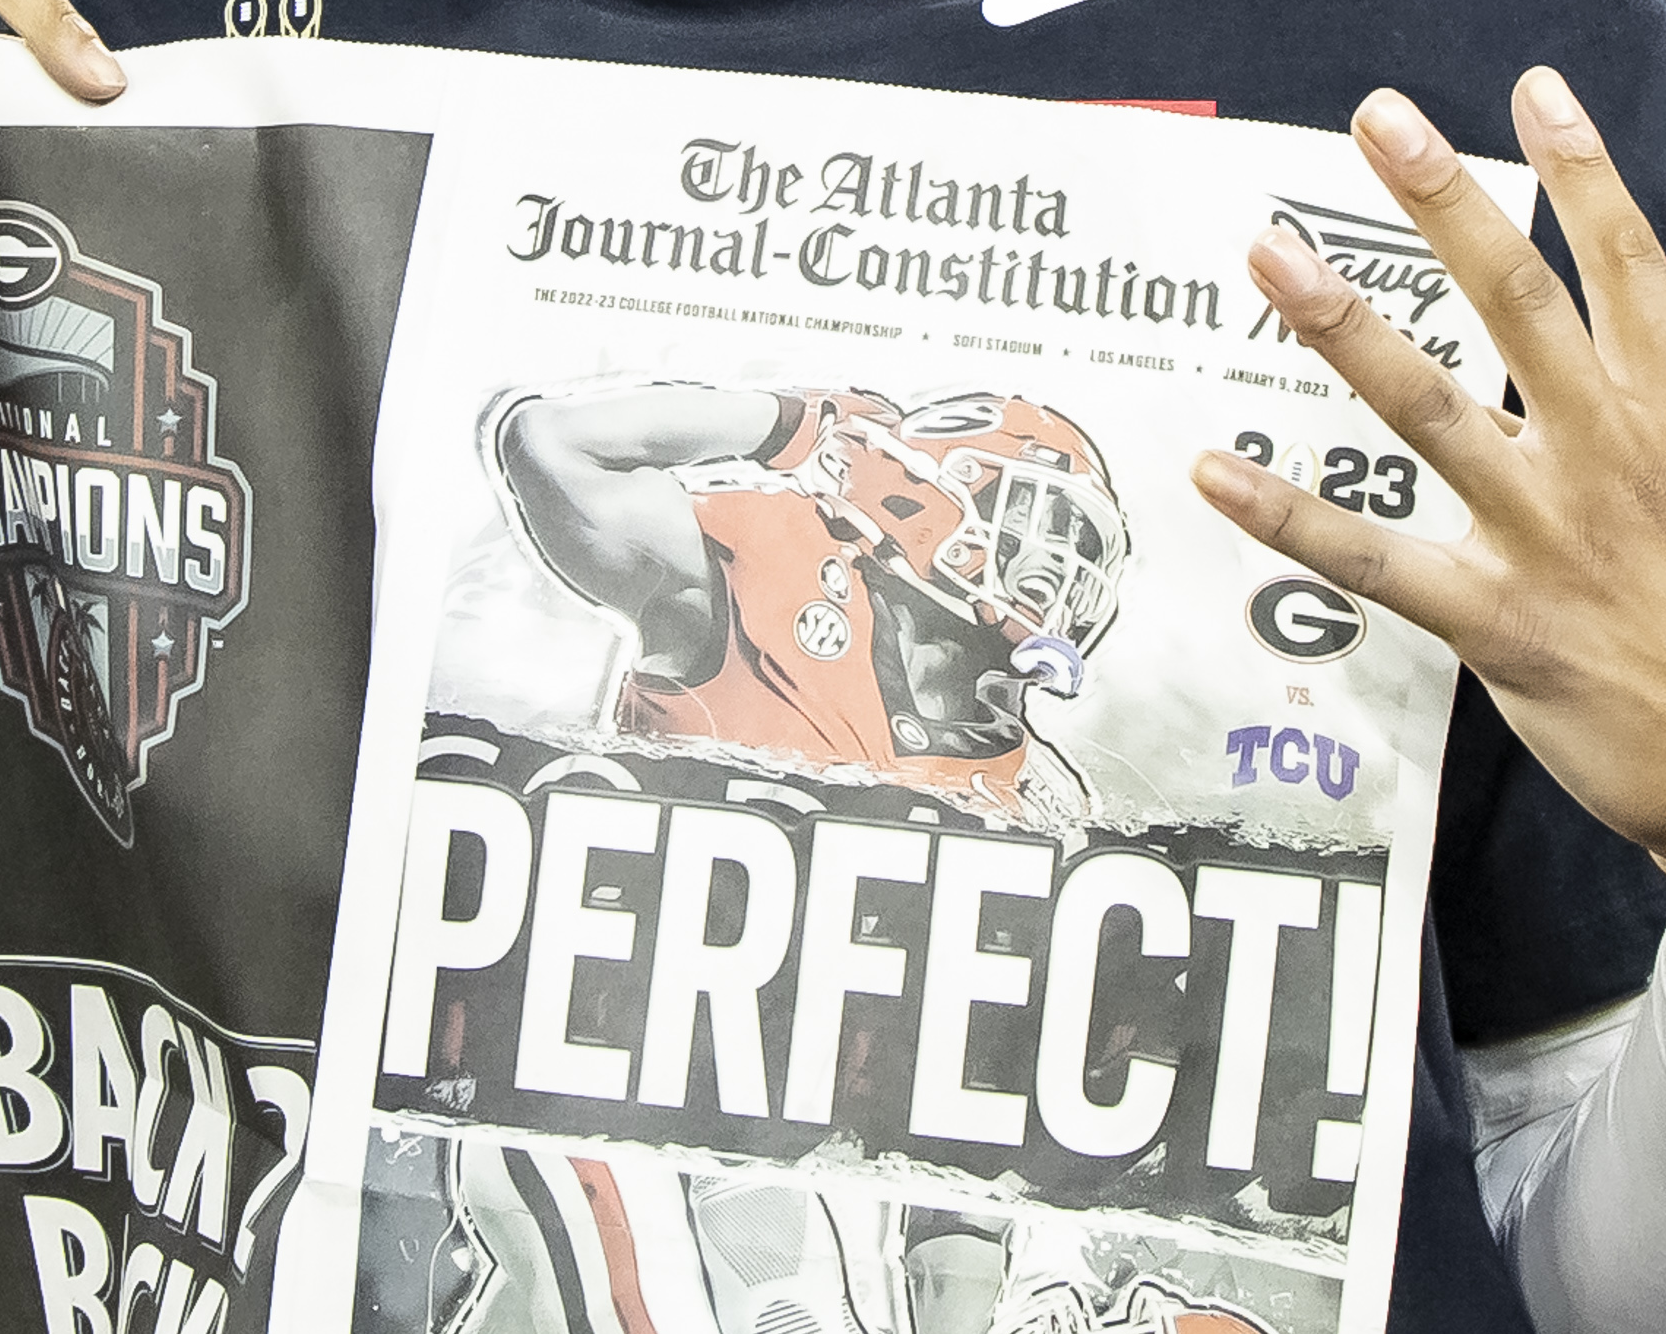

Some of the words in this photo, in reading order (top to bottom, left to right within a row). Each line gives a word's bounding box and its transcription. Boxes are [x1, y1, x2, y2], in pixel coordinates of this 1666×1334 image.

[681, 138, 804, 214] The
[810, 152, 1071, 238] Atlanta
[507, 194, 1224, 331] Journal-Constitution
[534, 288, 556, 304] THE
[560, 290, 616, 309] 2022-23
[619, 297, 672, 316] COLLEGE
[676, 303, 737, 323] FOOTBALL
[741, 309, 801, 330] NATIONAL
[805, 317, 903, 340] CHAMPIONSHIP
[953, 333, 983, 350] SOFI
[986, 337, 1043, 356] STADIUM
[1089, 349, 1114, 365] LOS
[1118, 352, 1175, 372] ANGELES
[1223, 367, 1275, 389] JANUARY
[1279, 377, 1291, 394] 9,
[1294, 379, 1329, 398] 2023
[1285, 685, 1314, 707] VS.
[1226, 725, 1360, 801] TCU
[381, 777, 1384, 1183] PERFECT!
